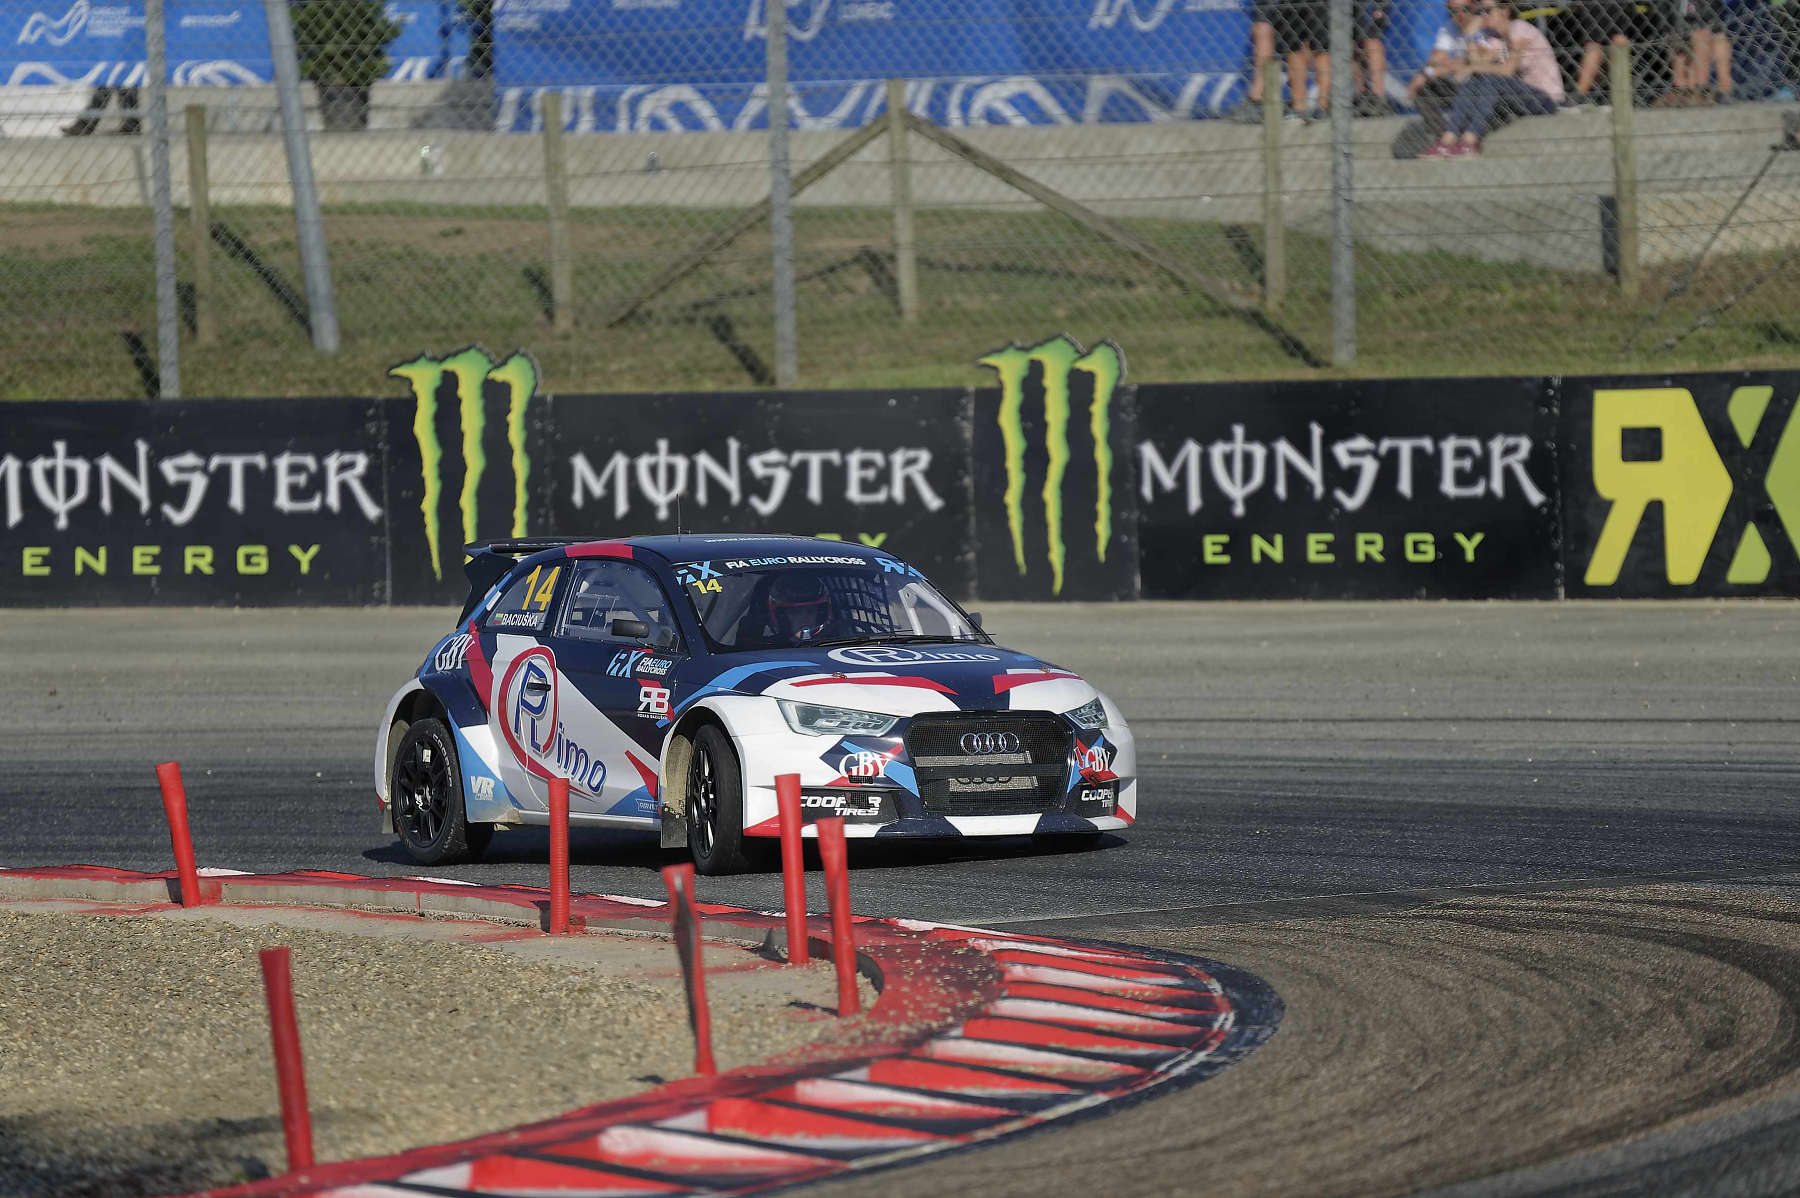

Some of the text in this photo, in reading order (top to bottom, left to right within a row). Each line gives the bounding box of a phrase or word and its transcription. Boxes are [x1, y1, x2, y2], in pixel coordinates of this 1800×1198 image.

[569, 436, 944, 520] MONSTER
[1136, 421, 1547, 516] MONSTER
[22, 544, 321, 576] ENERGY
[1202, 532, 1486, 565] ENERGY
[725, 556, 867, 570] FIA EURO RALLYCROSS
[522, 564, 560, 612] 14
[692, 578, 723, 595] 14
[501, 611, 538, 627] BACIUŠKA
[435, 633, 475, 671] GBY
[637, 686, 671, 713] RB
[839, 751, 892, 778] GBY
[1085, 746, 1111, 773] GBY
[470, 775, 495, 797] VR
[833, 807, 880, 816] TIRES
